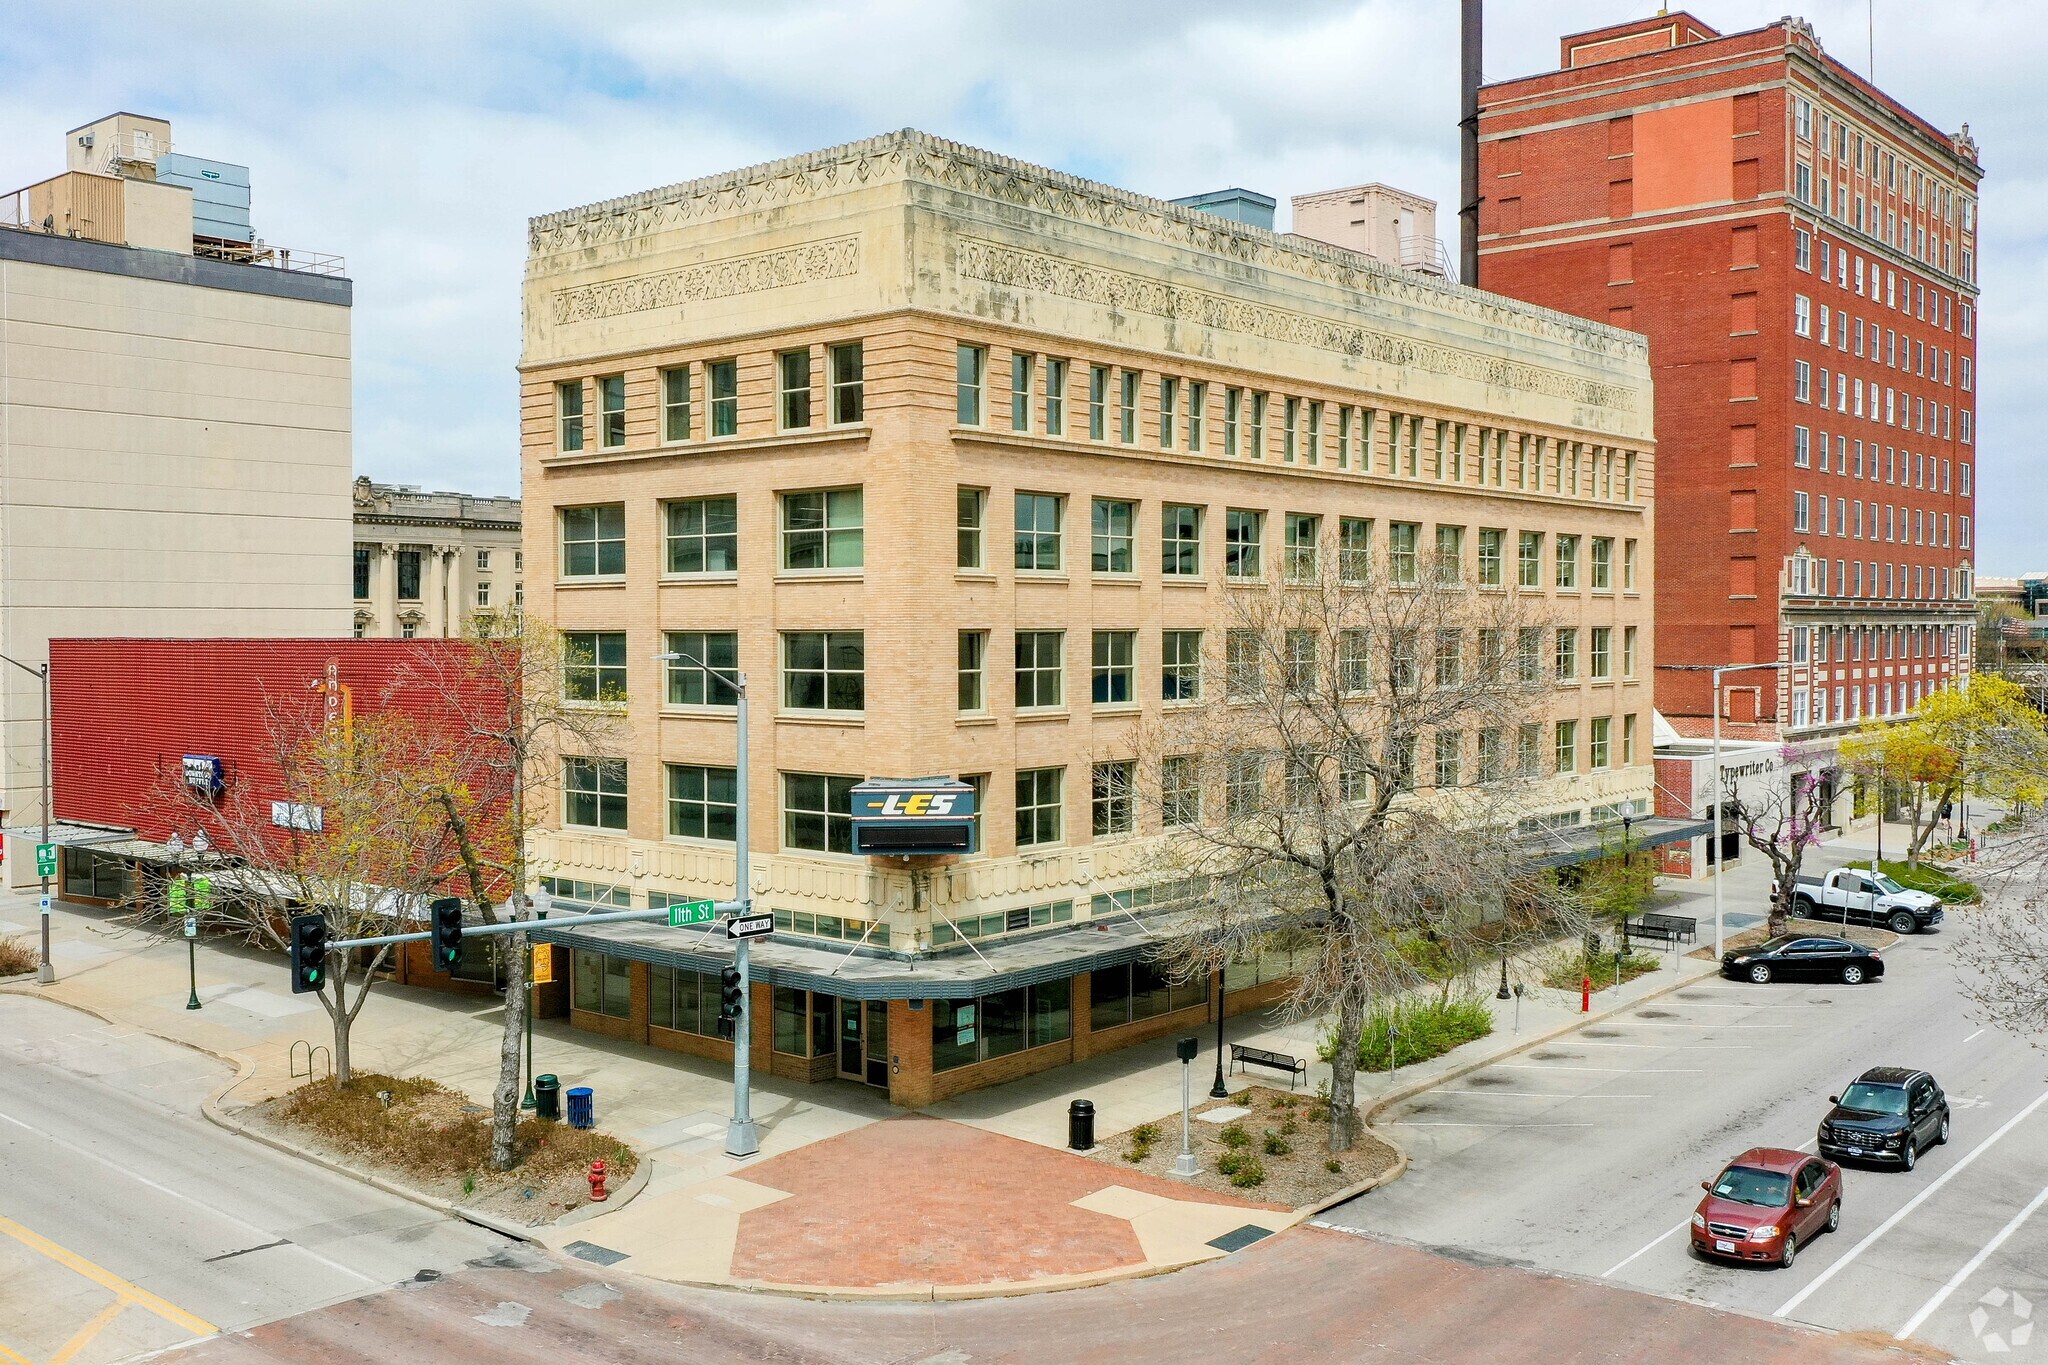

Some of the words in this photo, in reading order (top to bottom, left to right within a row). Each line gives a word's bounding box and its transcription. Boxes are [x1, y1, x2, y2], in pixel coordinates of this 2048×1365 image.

[1719, 760, 1764, 784] Typewriter
[1764, 758, 1774, 772] Co
[880, 794, 958, 815] LES
[674, 906, 692, 924] 11th
[697, 903, 710, 920] St
[739, 922, 754, 932] ONE
[755, 919, 770, 929] WAY
